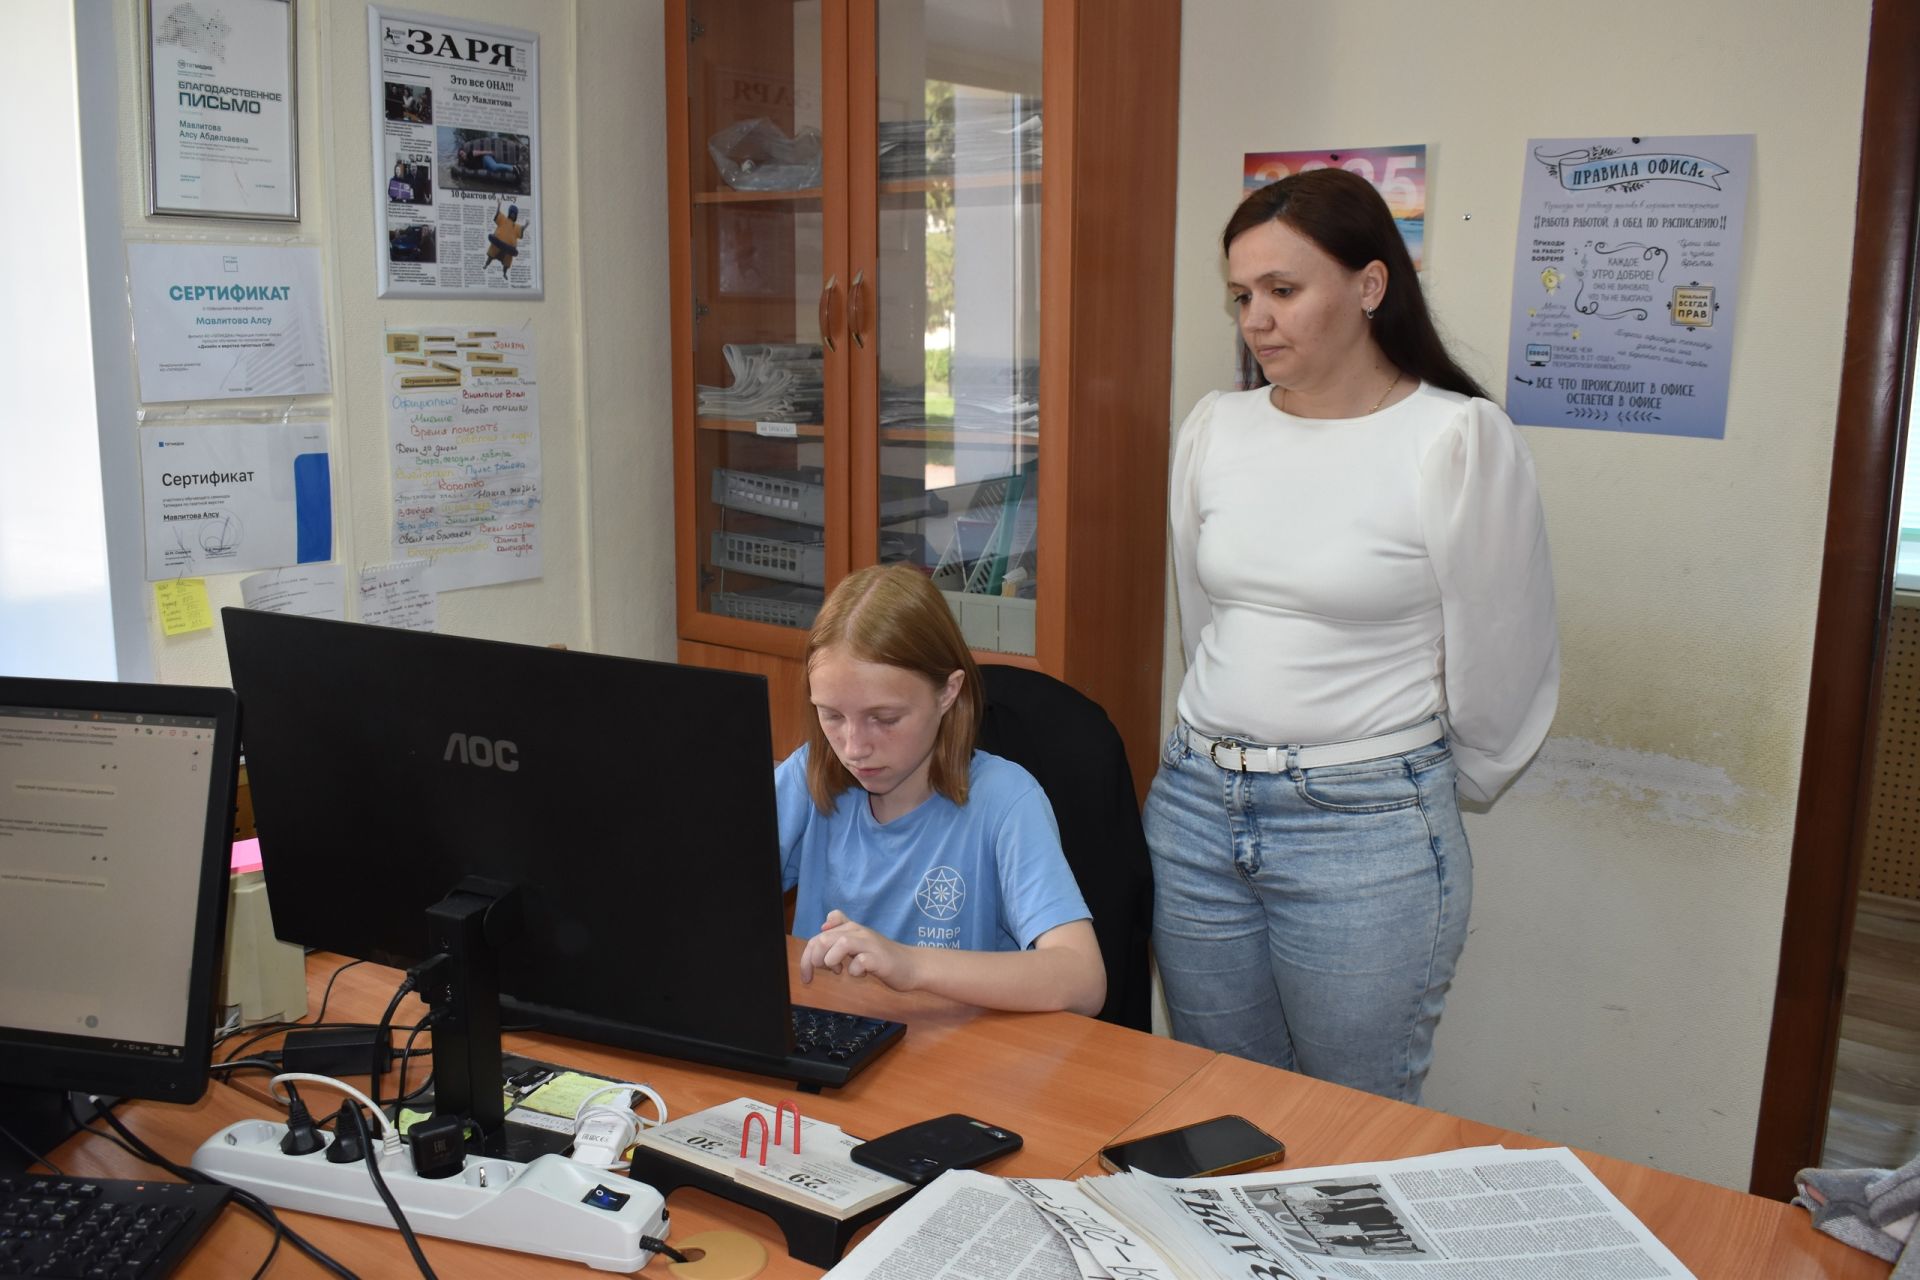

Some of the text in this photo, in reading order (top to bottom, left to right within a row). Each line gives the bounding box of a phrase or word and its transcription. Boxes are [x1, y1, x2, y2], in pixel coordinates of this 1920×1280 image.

[406, 28, 515, 68] ЗАРЯ
[450, 74, 514, 92] Это все ОНА!!!
[178, 81, 282, 102] БЛАГОДАРСТВЕННОЕ
[179, 92, 261, 114] ПИСЬМО
[453, 93, 512, 108] Алсу Мавлитова
[179, 120, 222, 132] Мавлитова
[179, 130, 198, 140] Алсу
[1572, 158, 1698, 186] ПРАВИЛА ОФИСА
[451, 190, 517, 204] 10 фактов об Алсу
[1613, 218, 1619, 228] А
[1622, 217, 1643, 228] ОБЕД
[1646, 217, 1659, 228] ПО
[1608, 257, 1639, 267] КАЖДОЕ
[1592, 269, 1614, 280] УТРО
[169, 284, 290, 302] СЕРТИФИКАТ
[196, 316, 272, 326] Мавлитова Алсу
[1678, 309, 1707, 318] ПРАВ
[1536, 377, 1553, 389] ВСЕ
[1558, 378, 1577, 391] ЧТО
[1581, 378, 1645, 394] ПРОИСХОДИТ
[1650, 380, 1656, 394] В
[1566, 392, 1662, 410] ОСТАЕТСЯ В ОФИСЕ
[162, 470, 254, 488] Сертификат
[163, 513, 202, 521] Мавлитова
[443, 732, 519, 772] AOC
[686, 1136, 724, 1150] 30
[788, 1174, 828, 1189] 29
